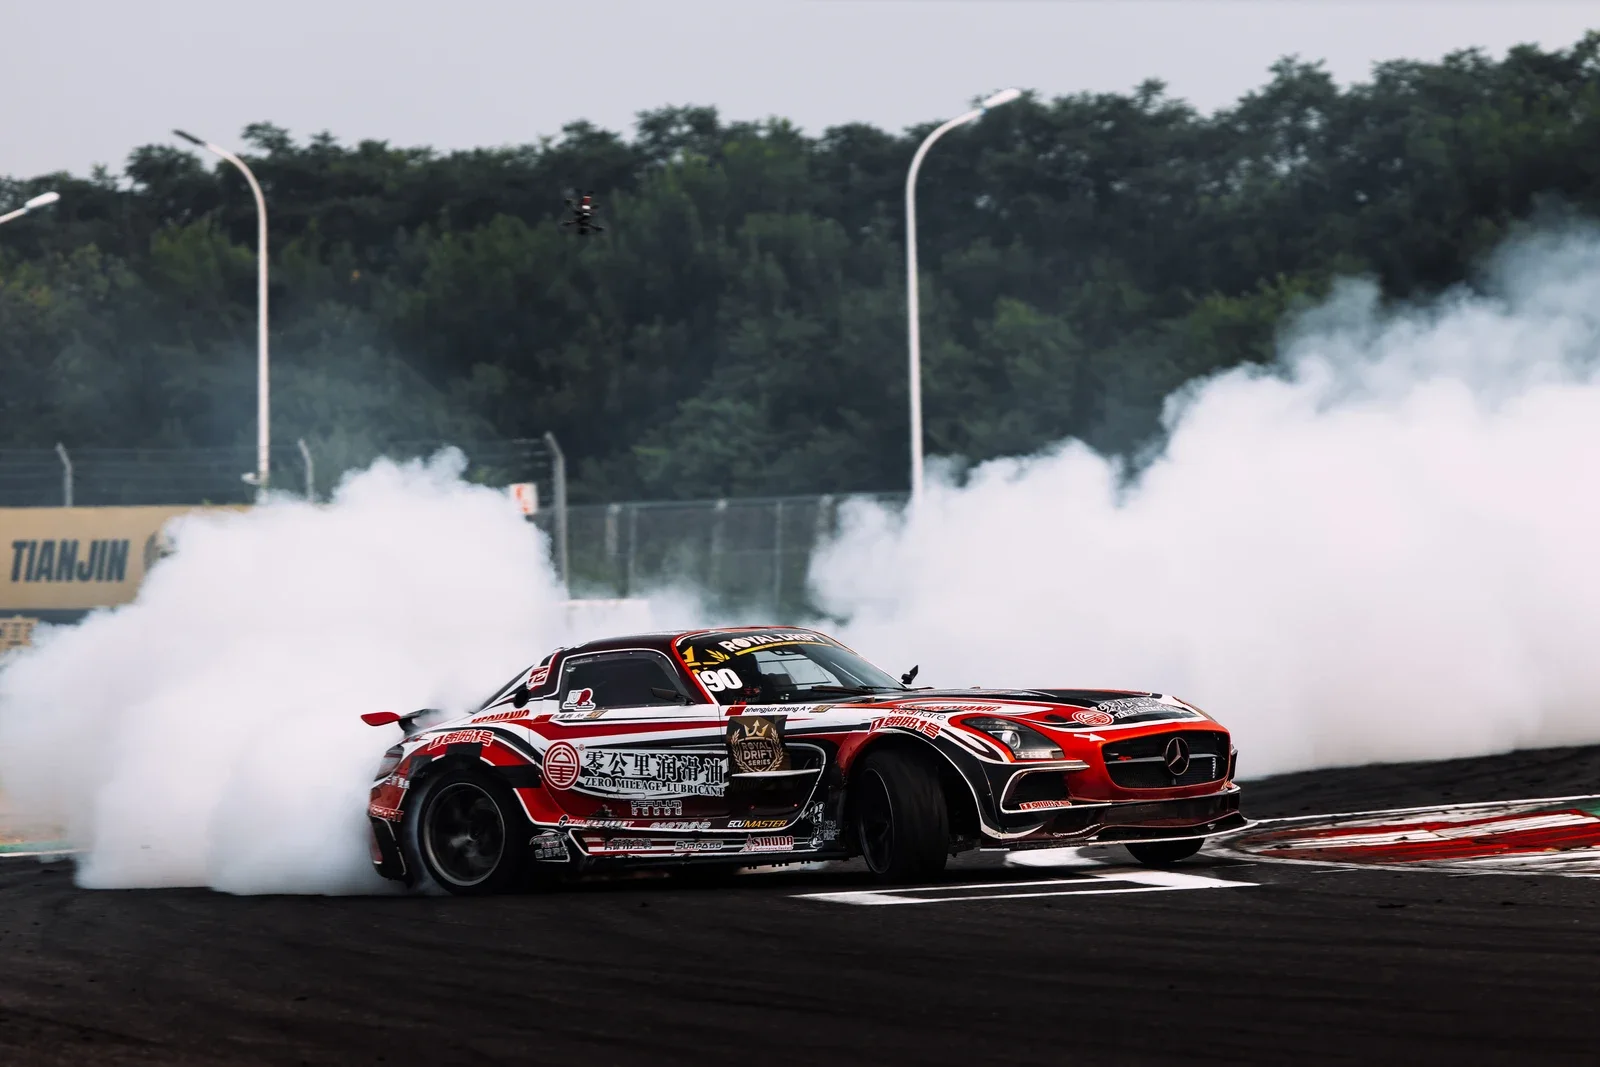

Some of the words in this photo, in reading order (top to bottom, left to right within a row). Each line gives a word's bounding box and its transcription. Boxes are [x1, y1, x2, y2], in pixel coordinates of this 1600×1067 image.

[11, 538, 131, 582] TIANJIN
[718, 634, 780, 652] ROYAL
[741, 741, 772, 750] ROYAL
[743, 750, 773, 760] DRIFT
[585, 751, 725, 784] 零公里润滑油
[585, 776, 612, 788] ZERO
[616, 779, 663, 791] MILEAGE
[667, 783, 726, 797] LUBRICANT
[753, 836, 795, 847] SIRUDA
